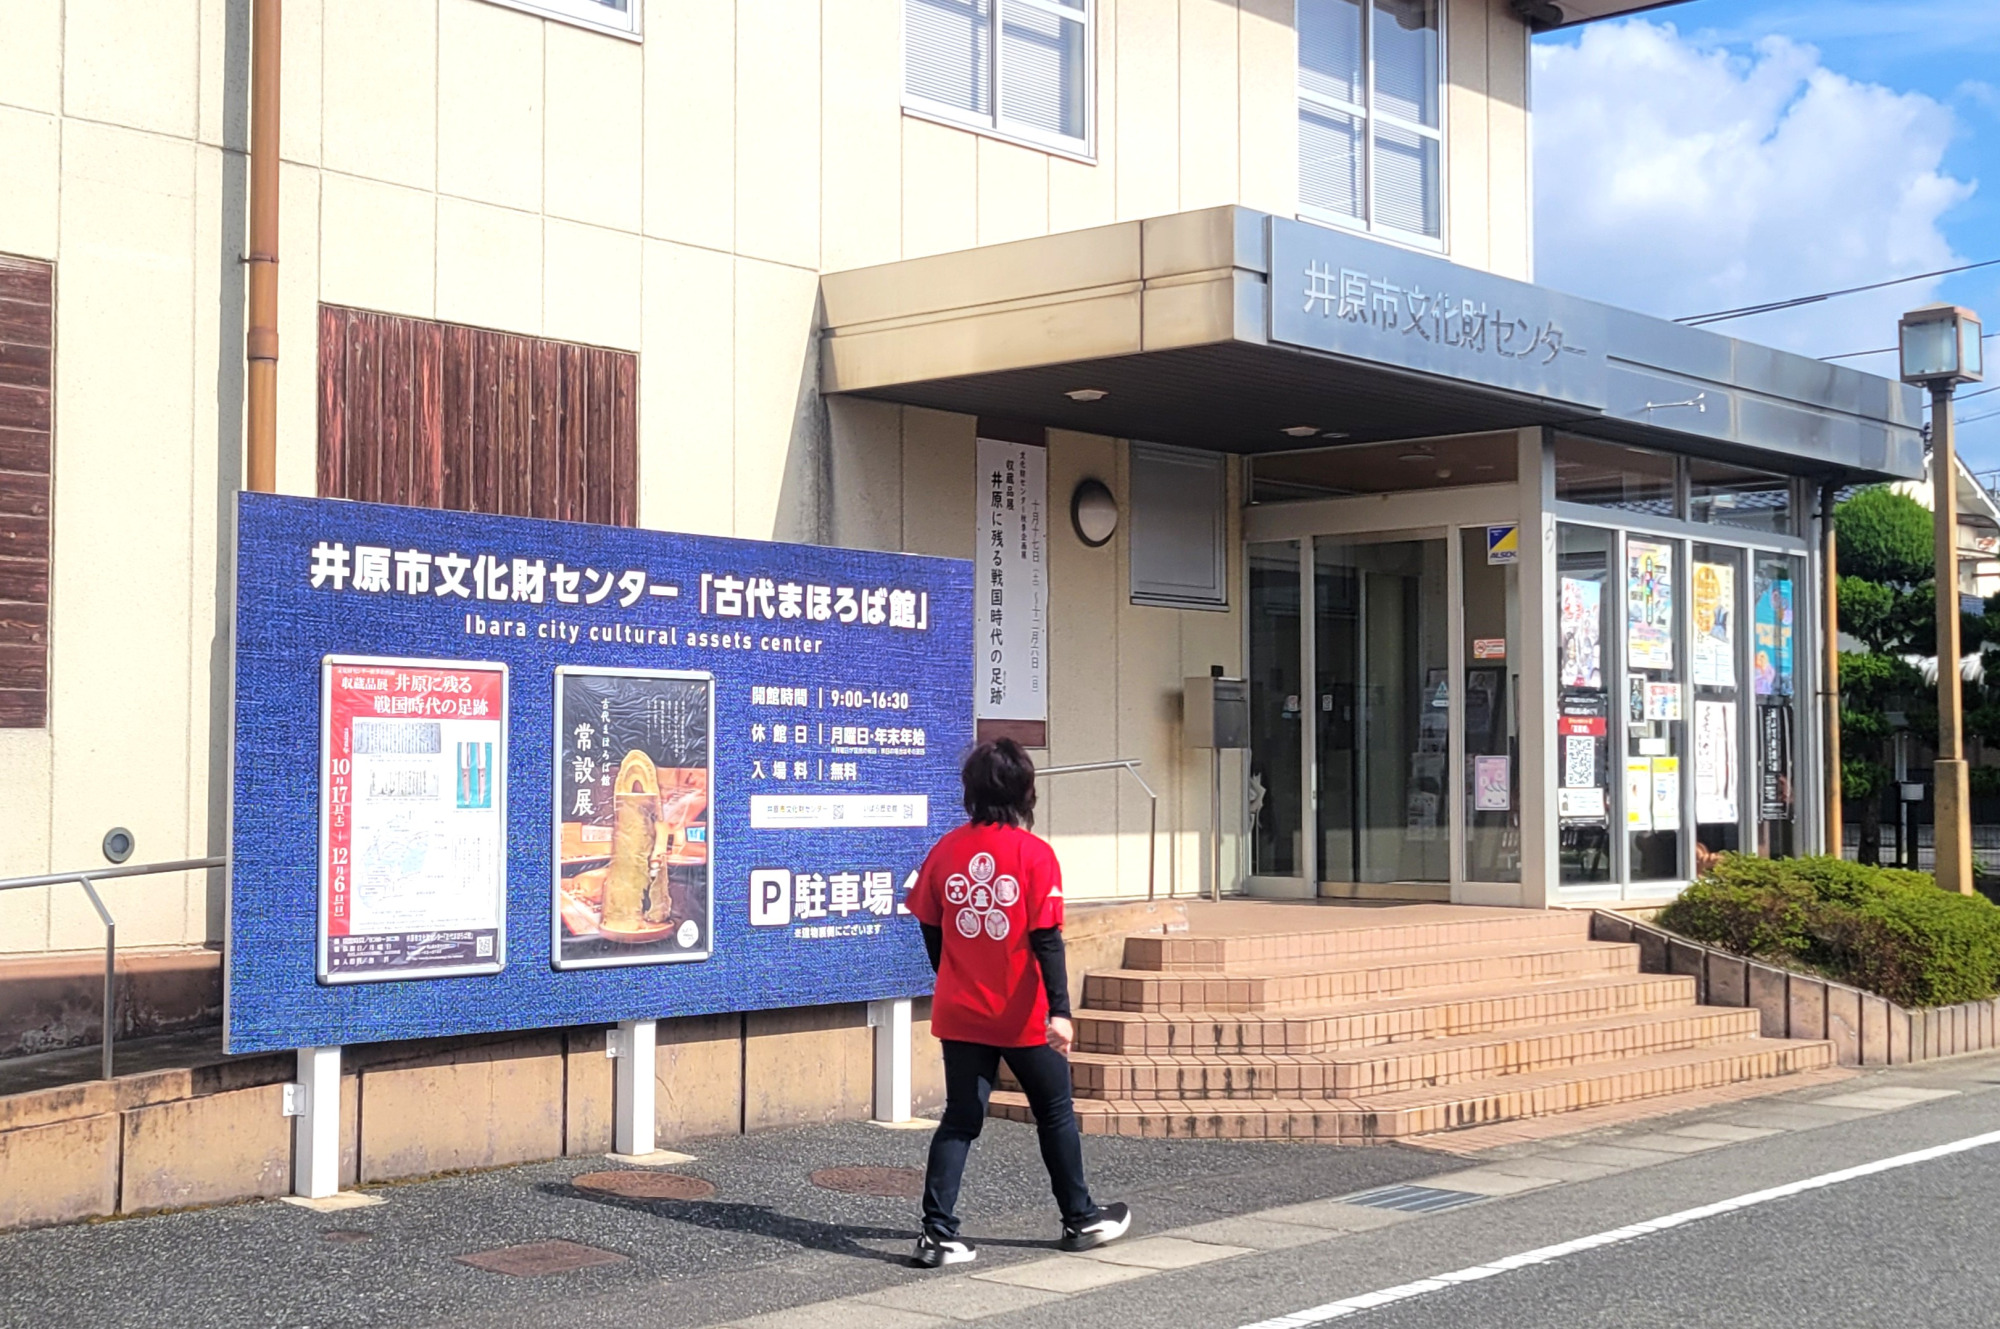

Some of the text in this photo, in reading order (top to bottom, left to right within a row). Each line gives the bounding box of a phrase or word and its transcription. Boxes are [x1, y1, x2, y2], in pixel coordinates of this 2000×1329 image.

[1303, 257, 1588, 366] 井原市文化財センター
[1005, 459, 1015, 511] 収蔵品展
[310, 541, 928, 630] 井原市文化財センター 「古代まほろば館」
[990, 470, 1004, 705] 井原に残る戦国時代の足跡
[465, 614, 823, 653] Ibara city cultural assets center
[341, 673, 473, 695] 収蔵品展 井原に残る
[373, 694, 489, 717] 戦国時代の足跡
[751, 685, 808, 707] 開館時間
[600, 697, 612, 787] 古代まほろば館
[571, 721, 596, 817] 常設展
[751, 760, 857, 781] 入場料 無料
[793, 871, 894, 920] 駐車場
